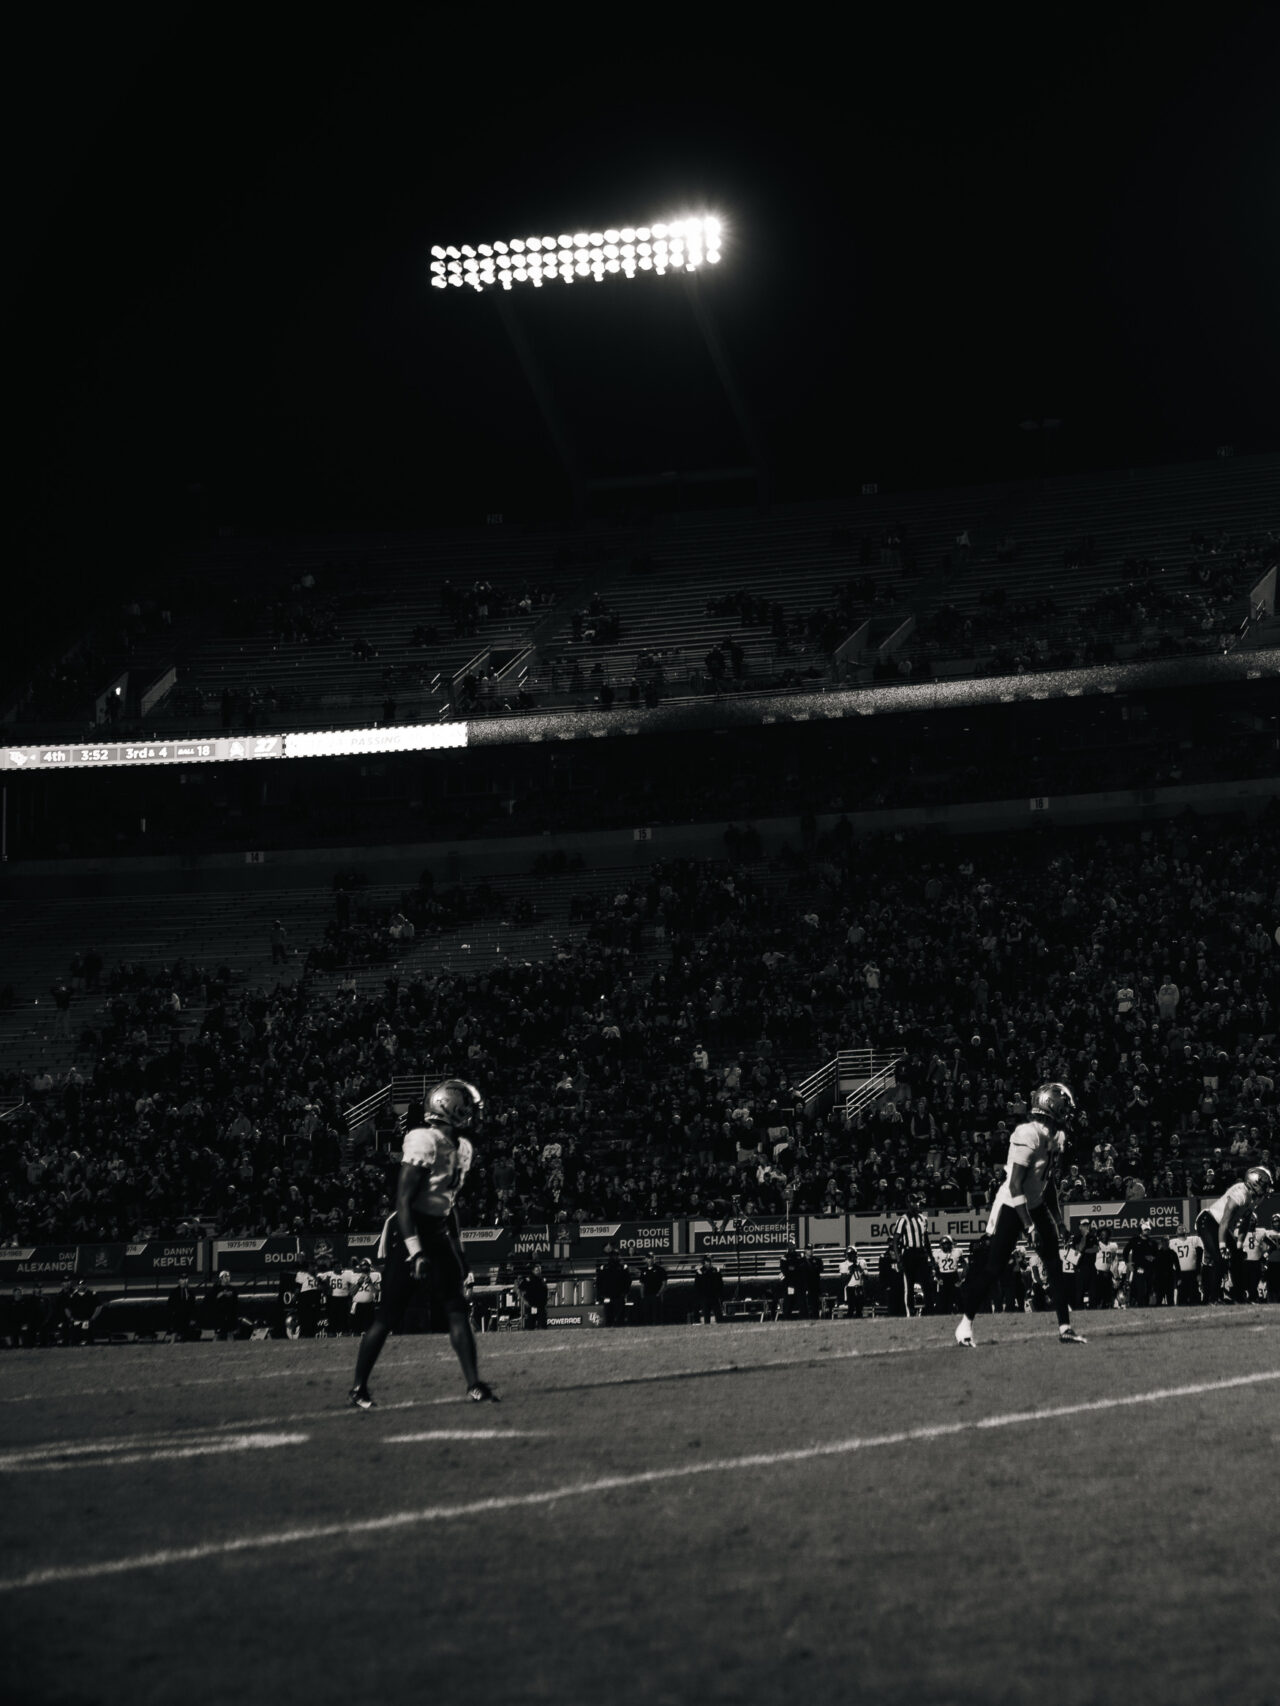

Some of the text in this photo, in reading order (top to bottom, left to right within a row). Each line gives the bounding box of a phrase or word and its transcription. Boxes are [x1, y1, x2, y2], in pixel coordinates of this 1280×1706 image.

[43, 751, 66, 762] 4th
[81, 749, 109, 761] 3:52
[158, 746, 168, 758] 4
[197, 745, 210, 757] 18
[638, 829, 647, 839] 15
[1092, 1205, 1102, 1213] 20
[1149, 1205, 1180, 1216] BOWL
[742, 1223, 796, 1233] CONFERENCE
[947, 1220, 988, 1234] FIELD
[1090, 1216, 1180, 1230] APPEARANCES
[462, 1230, 493, 1239] 1977-1980
[637, 1227, 670, 1237] TOOTIE
[619, 1237, 670, 1249] ROBBINS
[703, 1232, 796, 1246] CHAMPIONSHIPS
[1248, 1237, 1255, 1250] 8
[163, 1247, 195, 1257] DANNY
[514, 1242, 551, 1253] INMAN
[1177, 1245, 1188, 1258] 57
[152, 1257, 194, 1268] KEPLEY
[1101, 1251, 1112, 1264] 12
[16, 1261, 74, 1273] ALEXANDE
[941, 1258, 955, 1271] 22
[330, 1278, 343, 1290] 66
